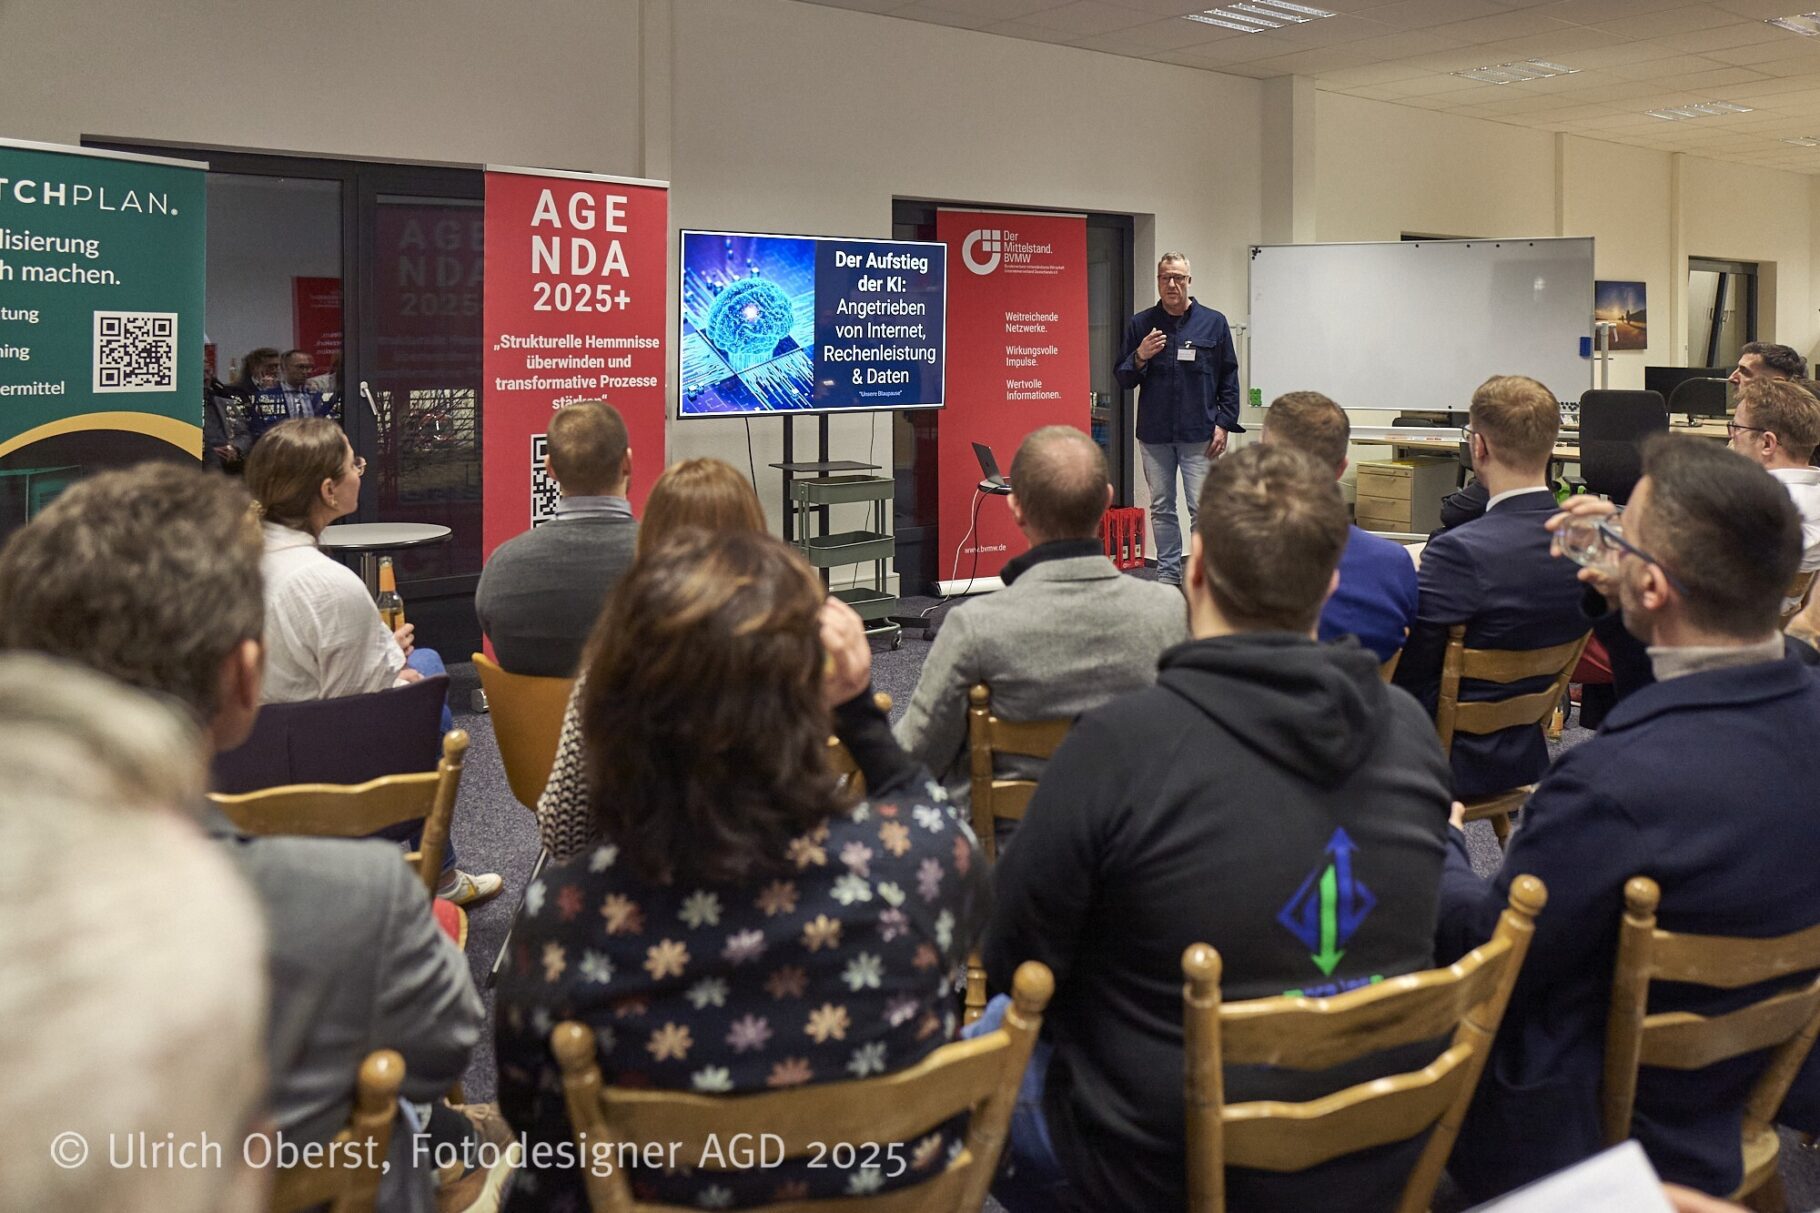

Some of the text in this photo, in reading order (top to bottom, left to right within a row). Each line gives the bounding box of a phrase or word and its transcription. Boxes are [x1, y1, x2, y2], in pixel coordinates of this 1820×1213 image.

[530, 188, 628, 234] AGE
[1003, 230, 1019, 241] Der
[1004, 241, 1053, 254] Mittelstand.
[531, 235, 630, 278] NDA
[835, 250, 929, 275] Der Aufstieg
[1004, 253, 1032, 263] BVMW
[22, 262, 121, 285] machen.
[858, 275, 906, 293] der KI:
[532, 282, 631, 313] 2025+
[0, 307, 40, 324] tung
[836, 298, 926, 320] Angetrieben
[1005, 312, 1059, 322] Weitreichende
[836, 322, 926, 341] von Internet,
[1005, 323, 1048, 333] Netzwerke.
[585, 335, 660, 349] Hemmnisse
[824, 344, 936, 364] Rechenleistung
[1006, 345, 1059, 357] Wirkungsvolle
[526, 354, 632, 369] überwinden und
[1006, 357, 1039, 368] Impulse.
[495, 375, 658, 391] transformative Prozesse
[852, 368, 909, 384] & Daten
[1006, 379, 1042, 389] Wertvolle
[1006, 391, 1062, 401] Informationen.
